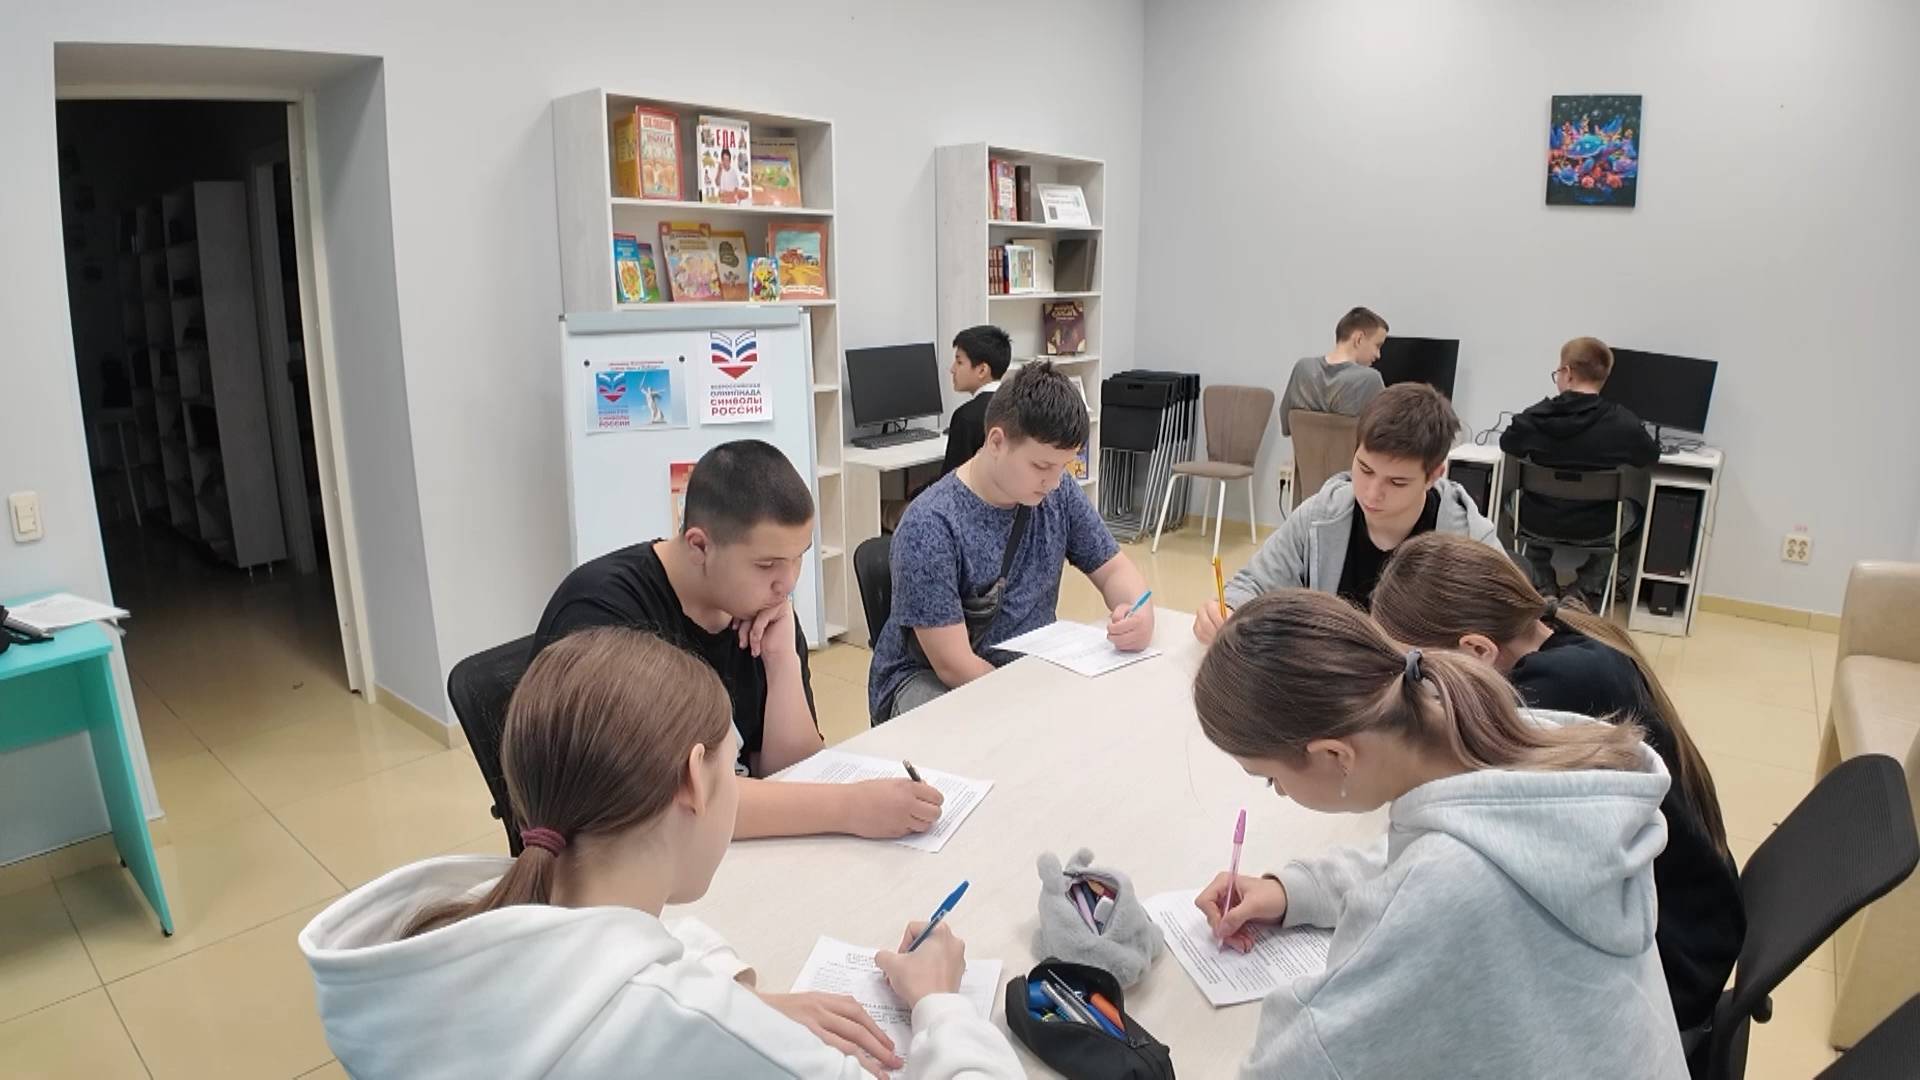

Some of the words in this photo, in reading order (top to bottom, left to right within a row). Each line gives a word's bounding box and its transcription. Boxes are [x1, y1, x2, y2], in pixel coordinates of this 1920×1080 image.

[716, 128, 736, 148] ЕДА
[710, 389, 762, 397] ОЛИМПИАДА
[710, 397, 762, 406] СИМВОЛЫ
[711, 405, 762, 416] РОССИИ
[598, 420, 630, 428] РОССИИ
